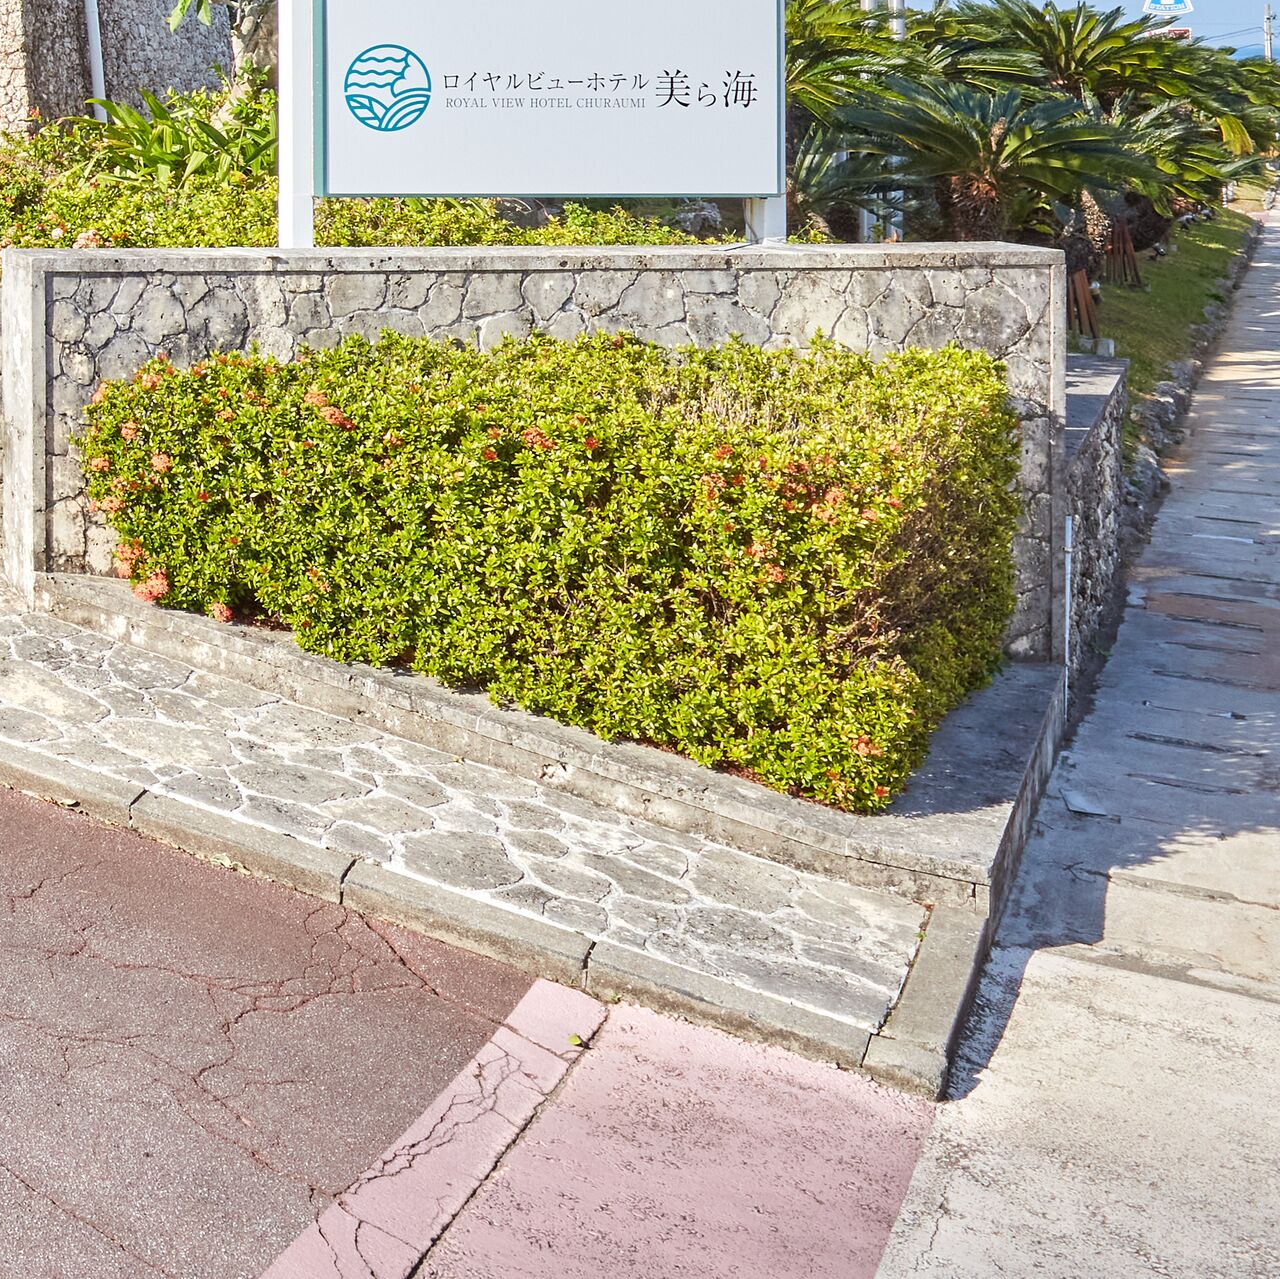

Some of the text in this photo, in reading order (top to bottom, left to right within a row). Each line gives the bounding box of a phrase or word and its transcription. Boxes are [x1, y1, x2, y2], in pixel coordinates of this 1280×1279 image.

[443, 69, 759, 109] ロイヤルビューホテル 美ら海
[445, 97, 647, 109] ROYAL VIEW HOTEL CHURAUMI
